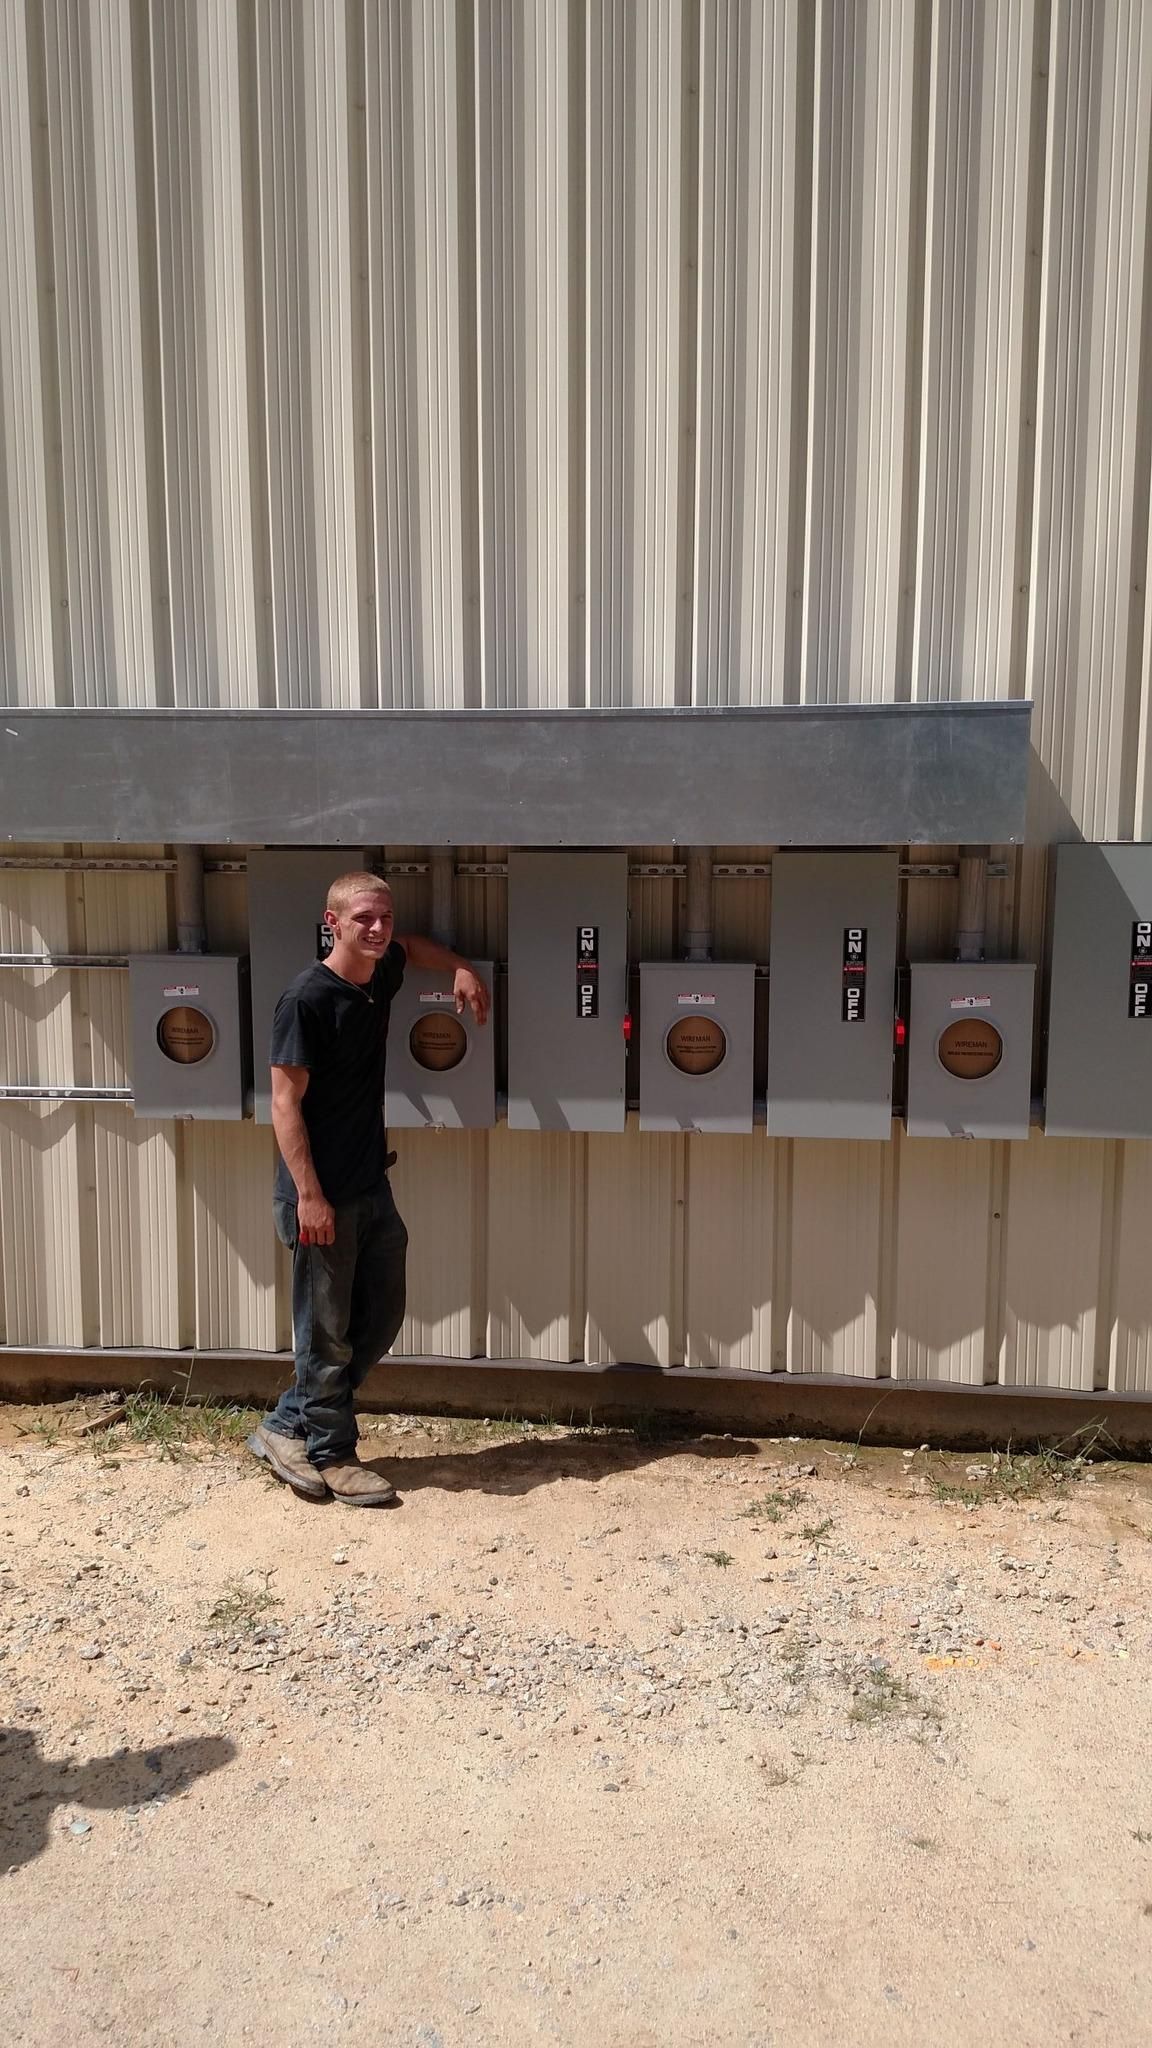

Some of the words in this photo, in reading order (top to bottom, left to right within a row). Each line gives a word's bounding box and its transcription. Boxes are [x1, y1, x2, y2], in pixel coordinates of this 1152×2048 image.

[581, 928, 594, 951] ON
[848, 929, 862, 953] ON
[1137, 922, 1151, 947] ON
[581, 985, 593, 1016] OFF
[847, 988, 860, 1021] OFF
[1134, 983, 1148, 1016] OFF
[954, 1040, 988, 1049] WIREMAN
